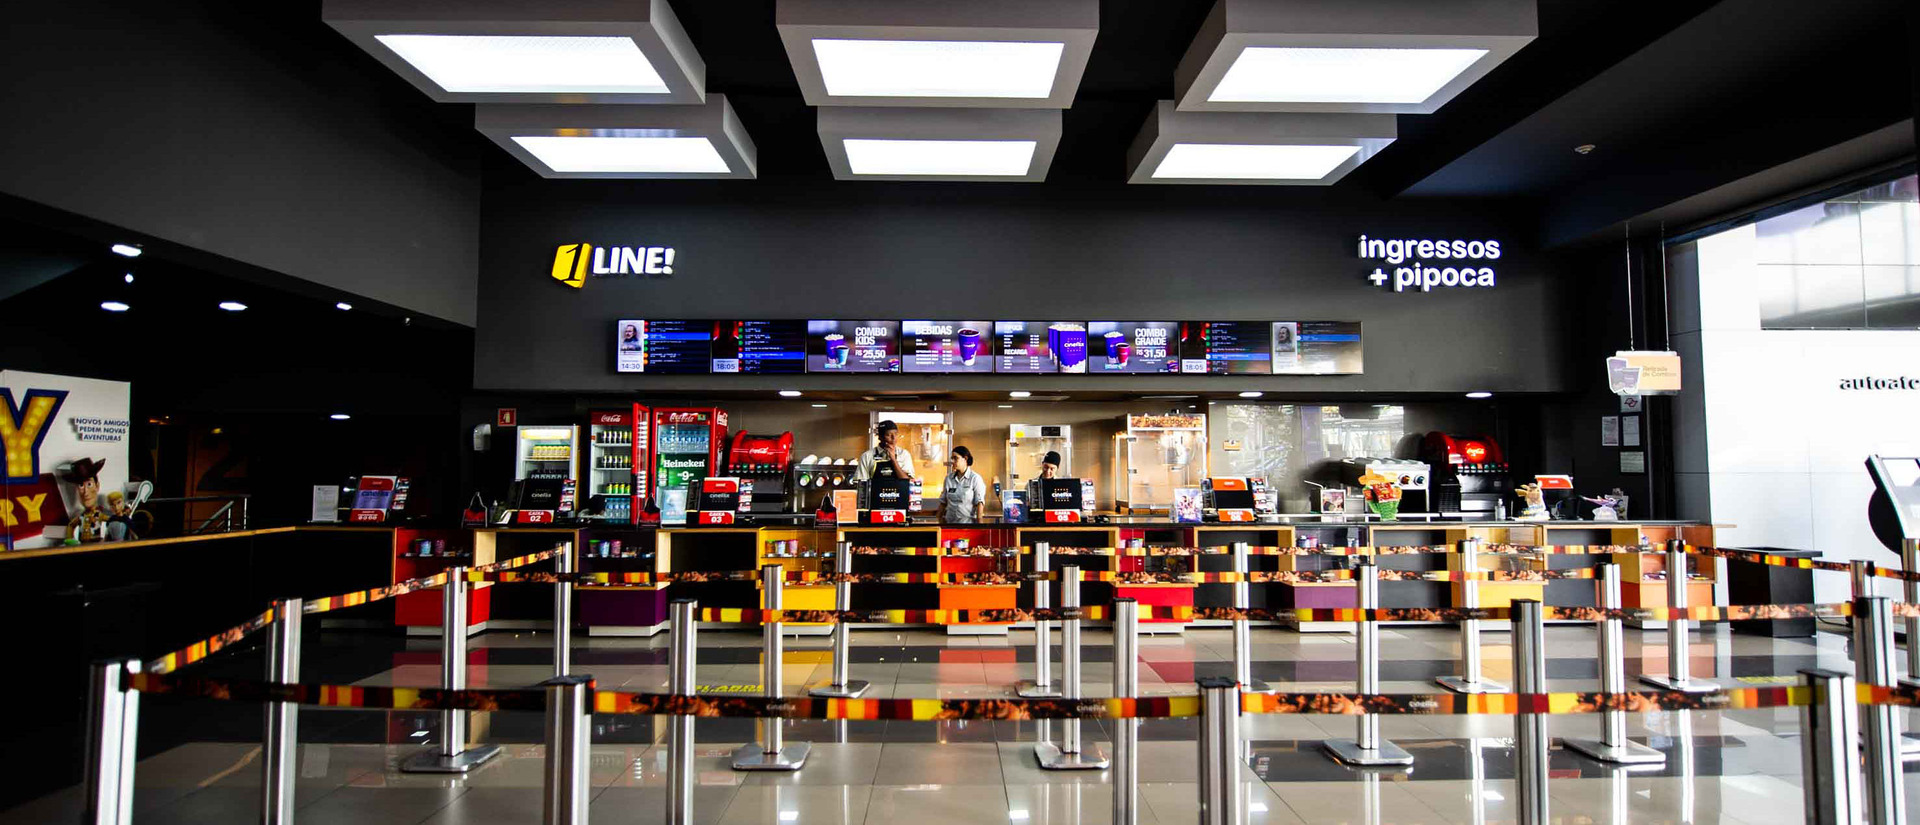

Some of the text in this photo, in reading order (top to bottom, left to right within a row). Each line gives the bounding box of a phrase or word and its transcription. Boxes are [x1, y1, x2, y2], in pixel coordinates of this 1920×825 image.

[1359, 234, 1501, 264] ingressos
[592, 246, 676, 275] LINE!
[1369, 262, 1495, 292] + pipoca
[855, 326, 888, 337] COMBO
[914, 325, 953, 336] BEBIDAS
[1134, 327, 1167, 338] COMBO
[855, 336, 876, 346] KIDS
[1134, 337, 1167, 346] GRANDE
[863, 349, 887, 359] 25,50
[1143, 348, 1167, 358] 31,50
[716, 363, 737, 371] 18:05
[75, 417, 130, 427] NOVOS AMIGOS
[103, 426, 126, 434] NOVAS
[83, 434, 122, 442] AVENTURAS
[663, 459, 705, 468] Heineken
